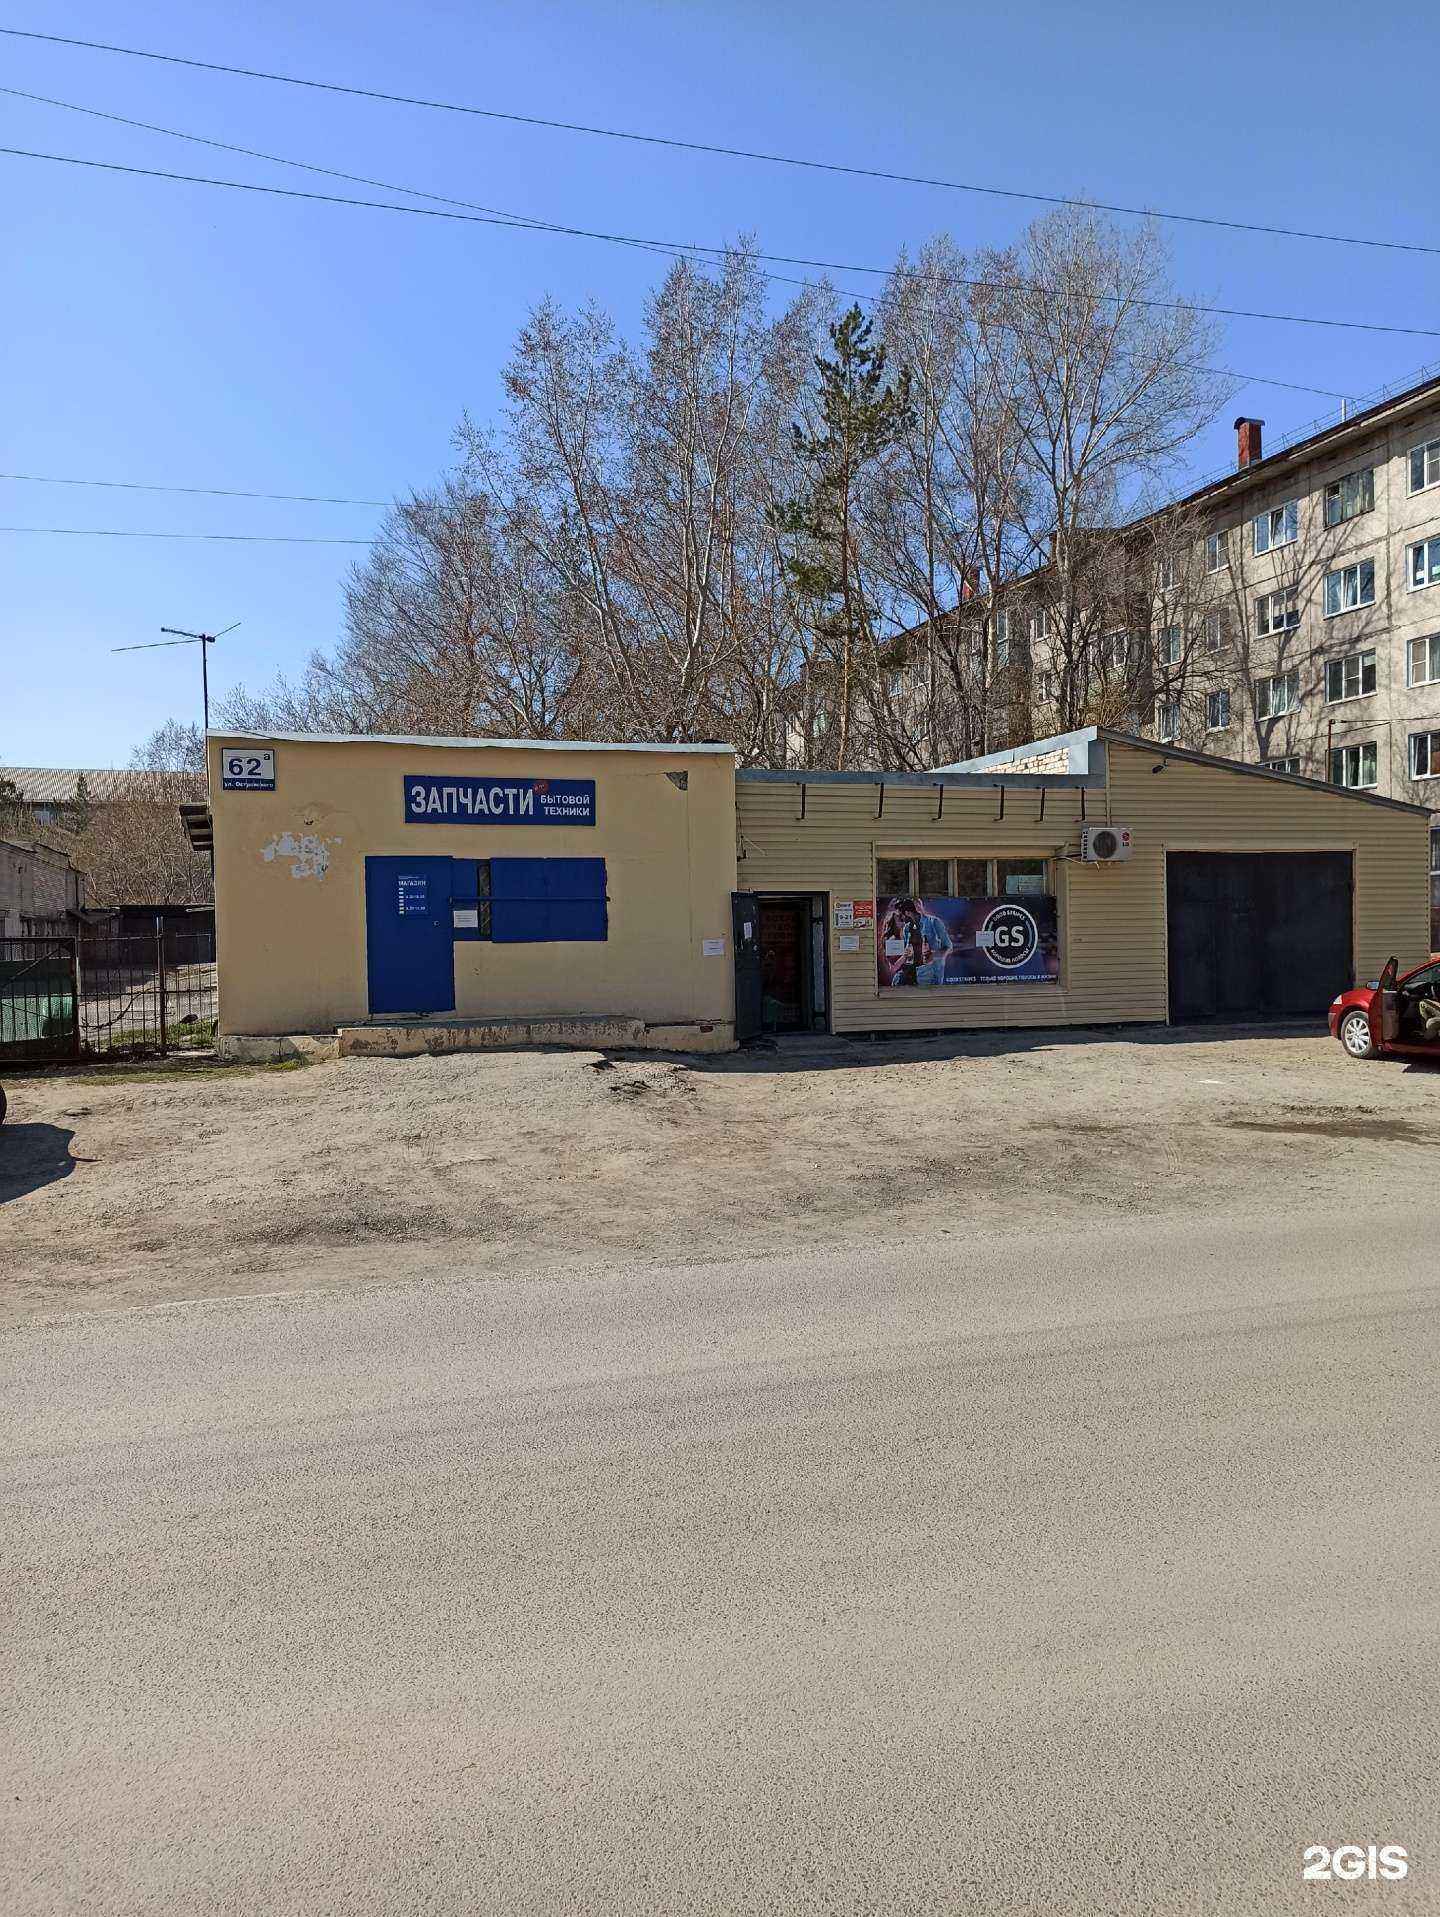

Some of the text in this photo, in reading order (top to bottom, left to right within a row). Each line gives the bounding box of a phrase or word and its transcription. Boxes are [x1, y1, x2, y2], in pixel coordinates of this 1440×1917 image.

[228, 758, 261, 776] 62
[411, 785, 534, 815] ЗАПЧАСТИ
[540, 794, 590, 805] БЫТОВОЙ
[543, 806, 590, 816] ТЕХНИКИ
[994, 925, 1025, 948] GS
